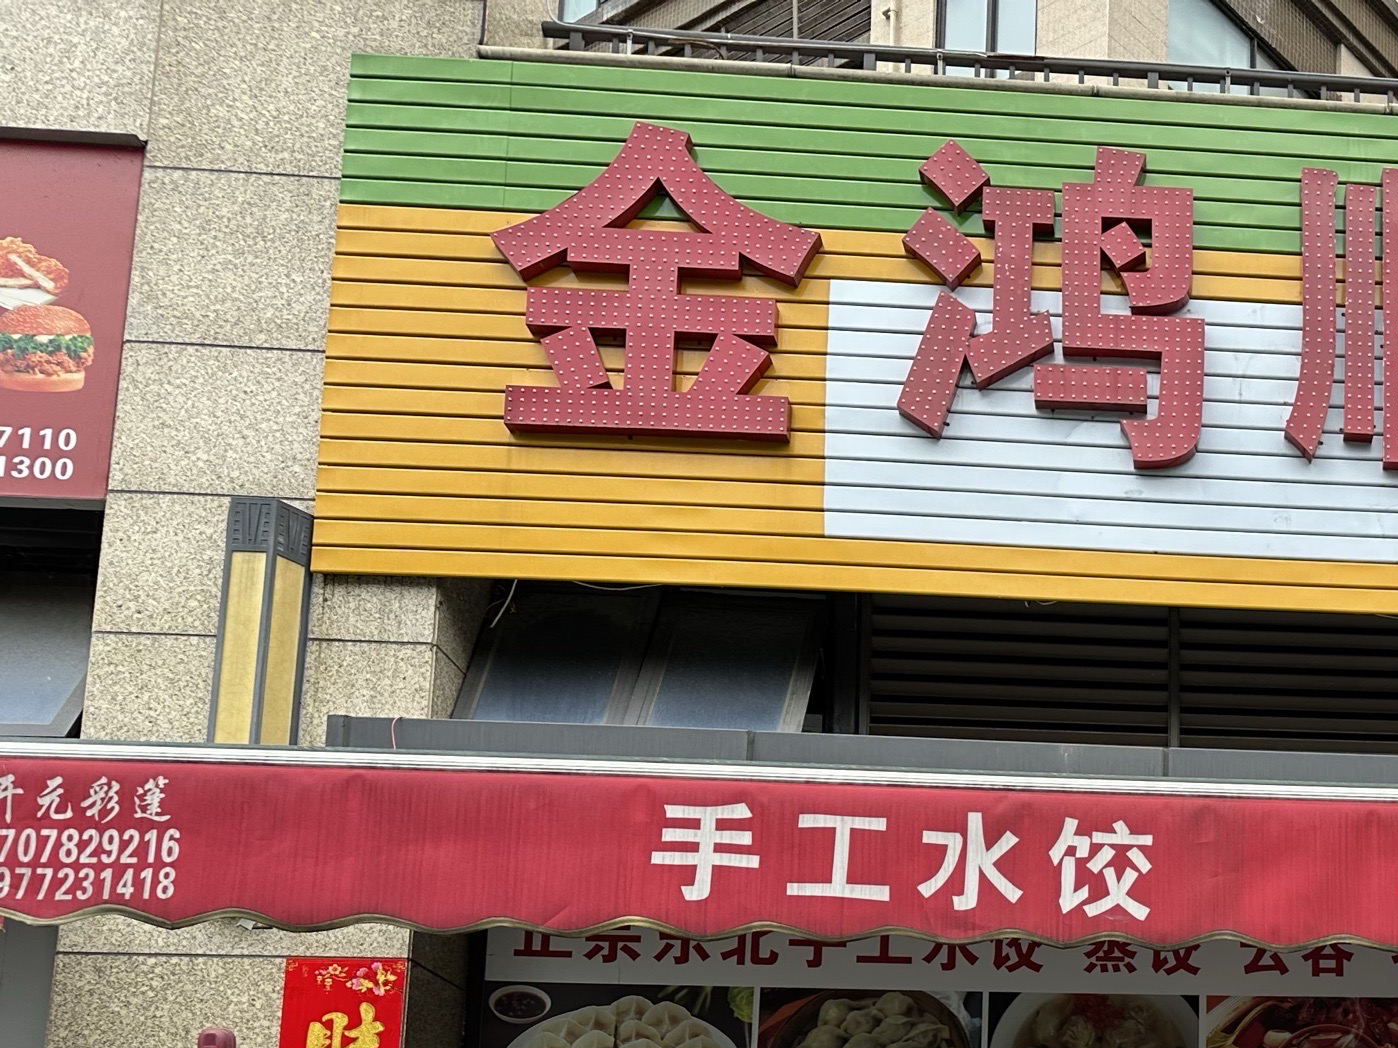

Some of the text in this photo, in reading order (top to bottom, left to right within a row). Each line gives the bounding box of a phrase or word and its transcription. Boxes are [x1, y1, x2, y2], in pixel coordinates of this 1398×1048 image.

[0, 426, 77, 451] 7110
[0, 455, 74, 480] 1300
[0, 828, 181, 864] 707829216
[650, 802, 1153, 921] 手工水饺
[0, 867, 176, 900] 977231418
